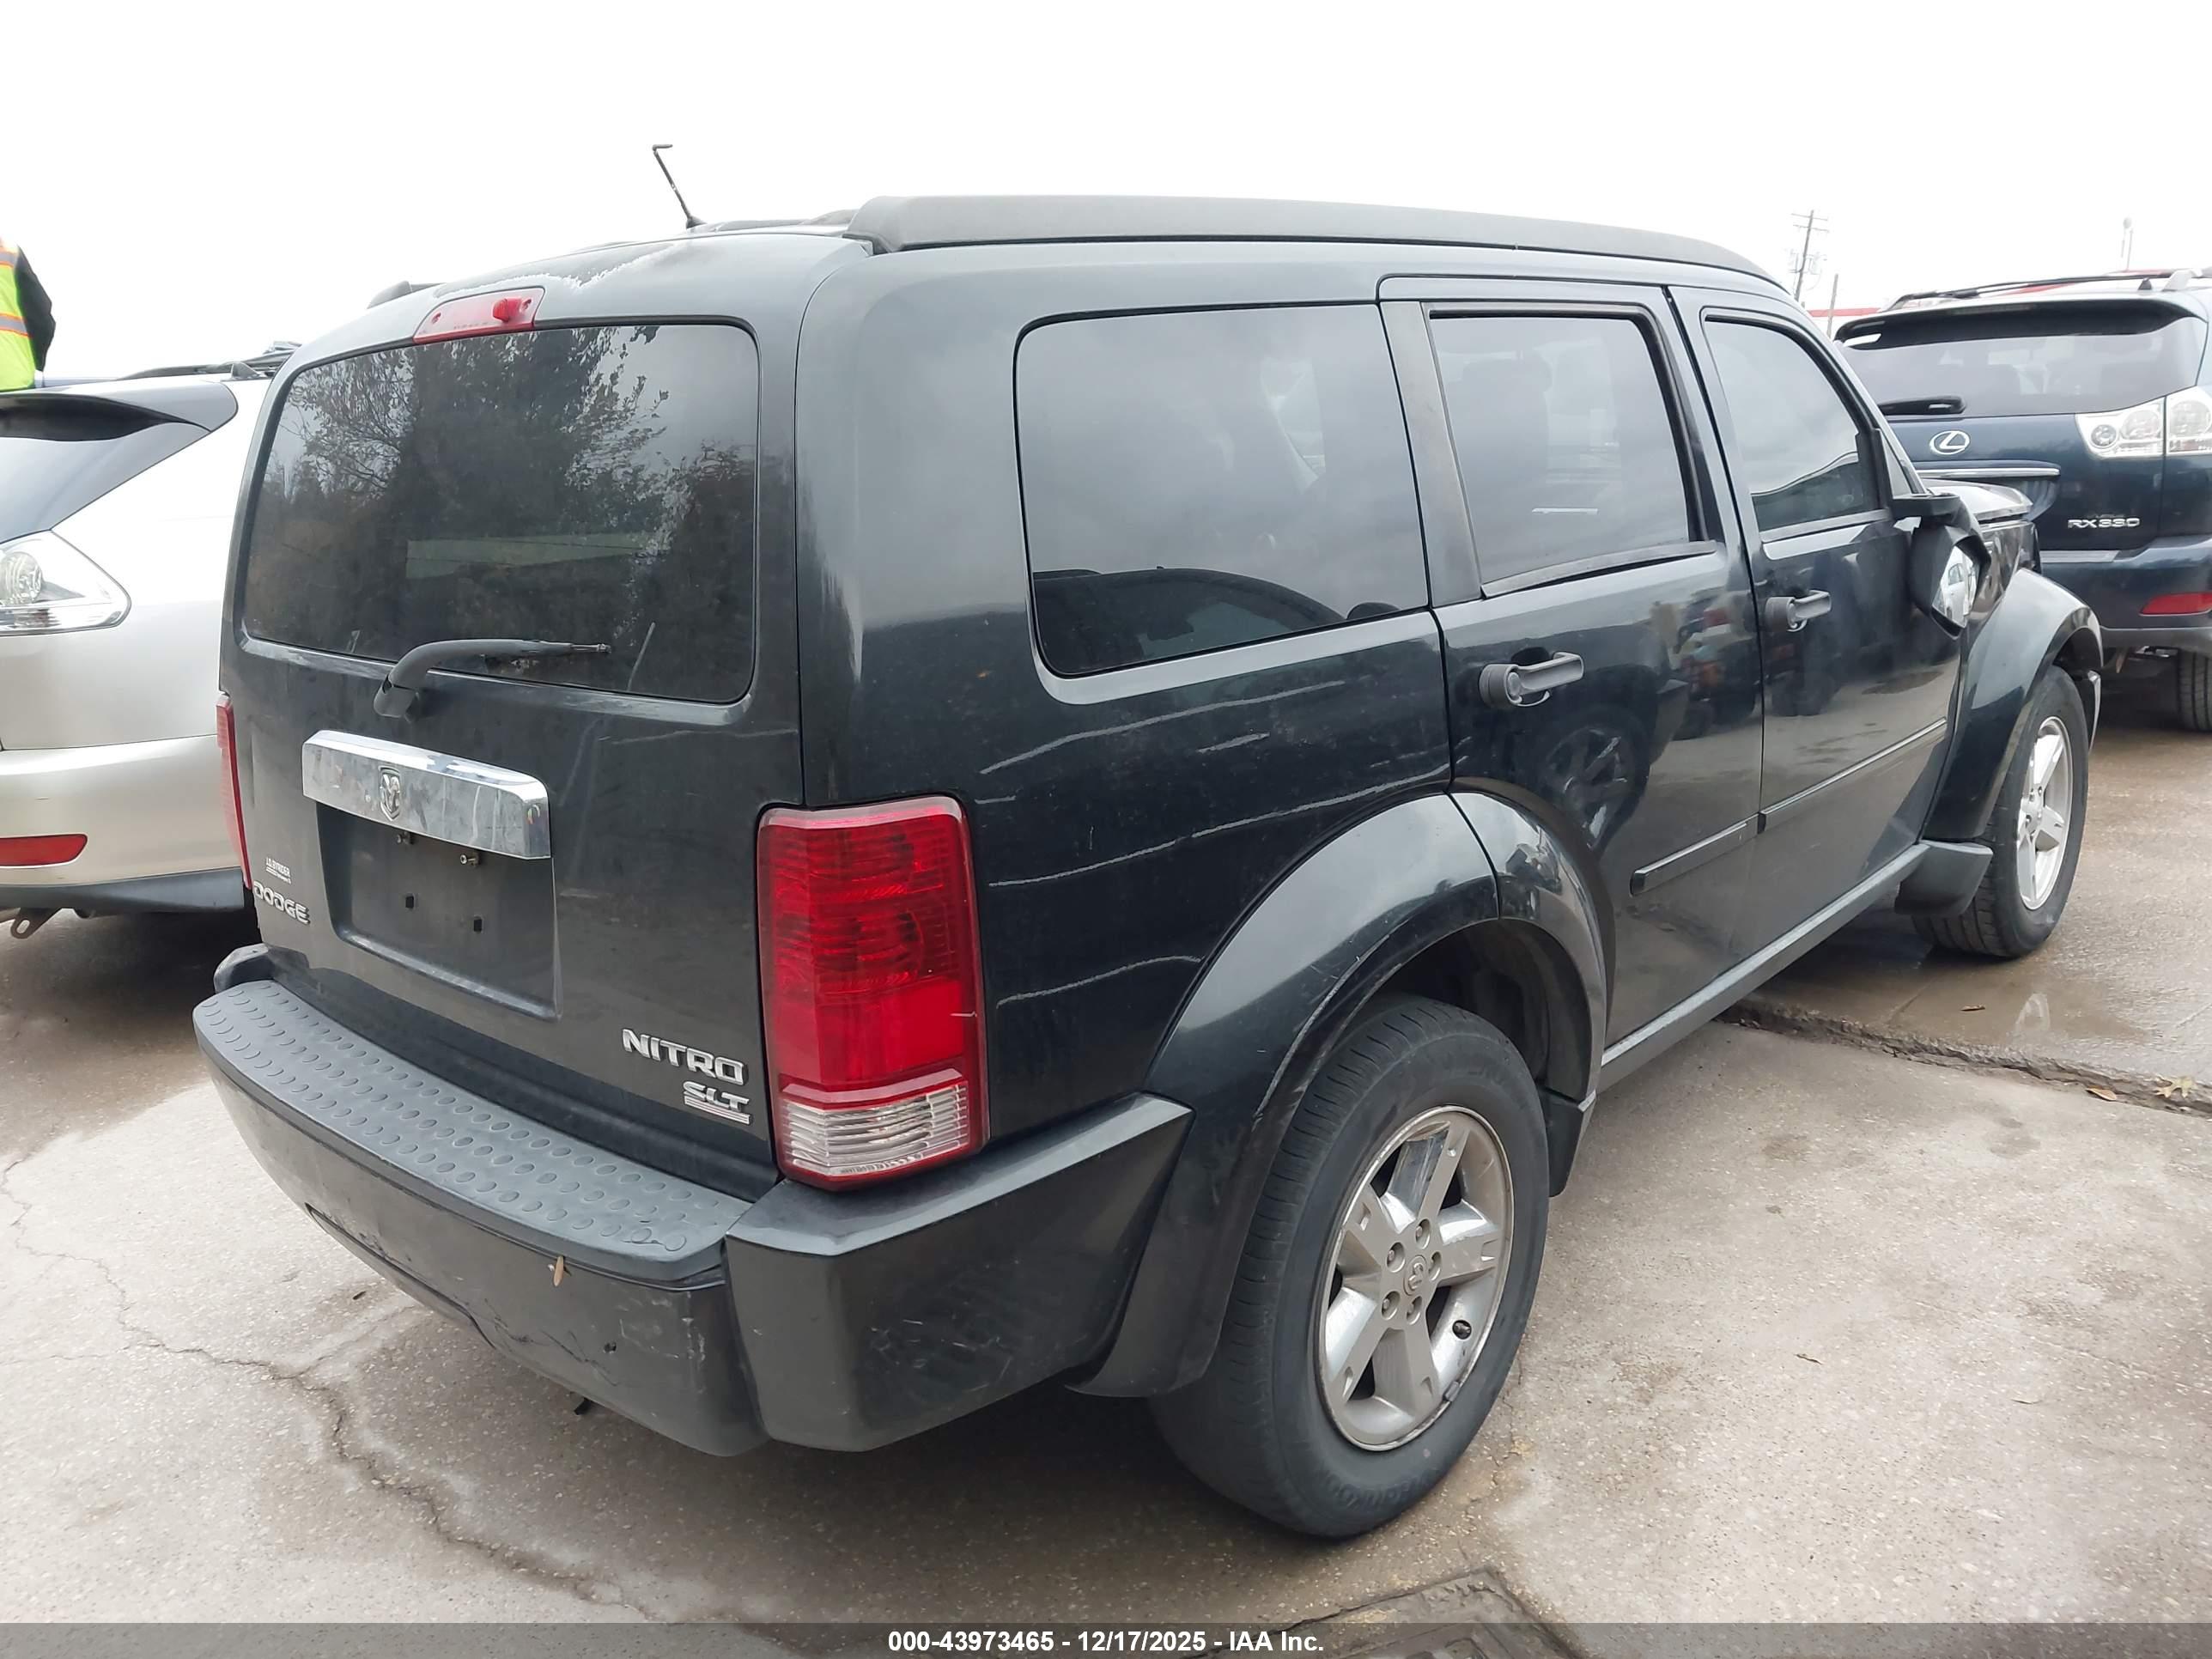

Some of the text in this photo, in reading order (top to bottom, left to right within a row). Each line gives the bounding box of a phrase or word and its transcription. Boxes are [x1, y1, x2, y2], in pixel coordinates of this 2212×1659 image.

[252, 879, 310, 925] DODGE
[623, 1028, 746, 1086] NITRO
[683, 1080, 750, 1112] SLT
